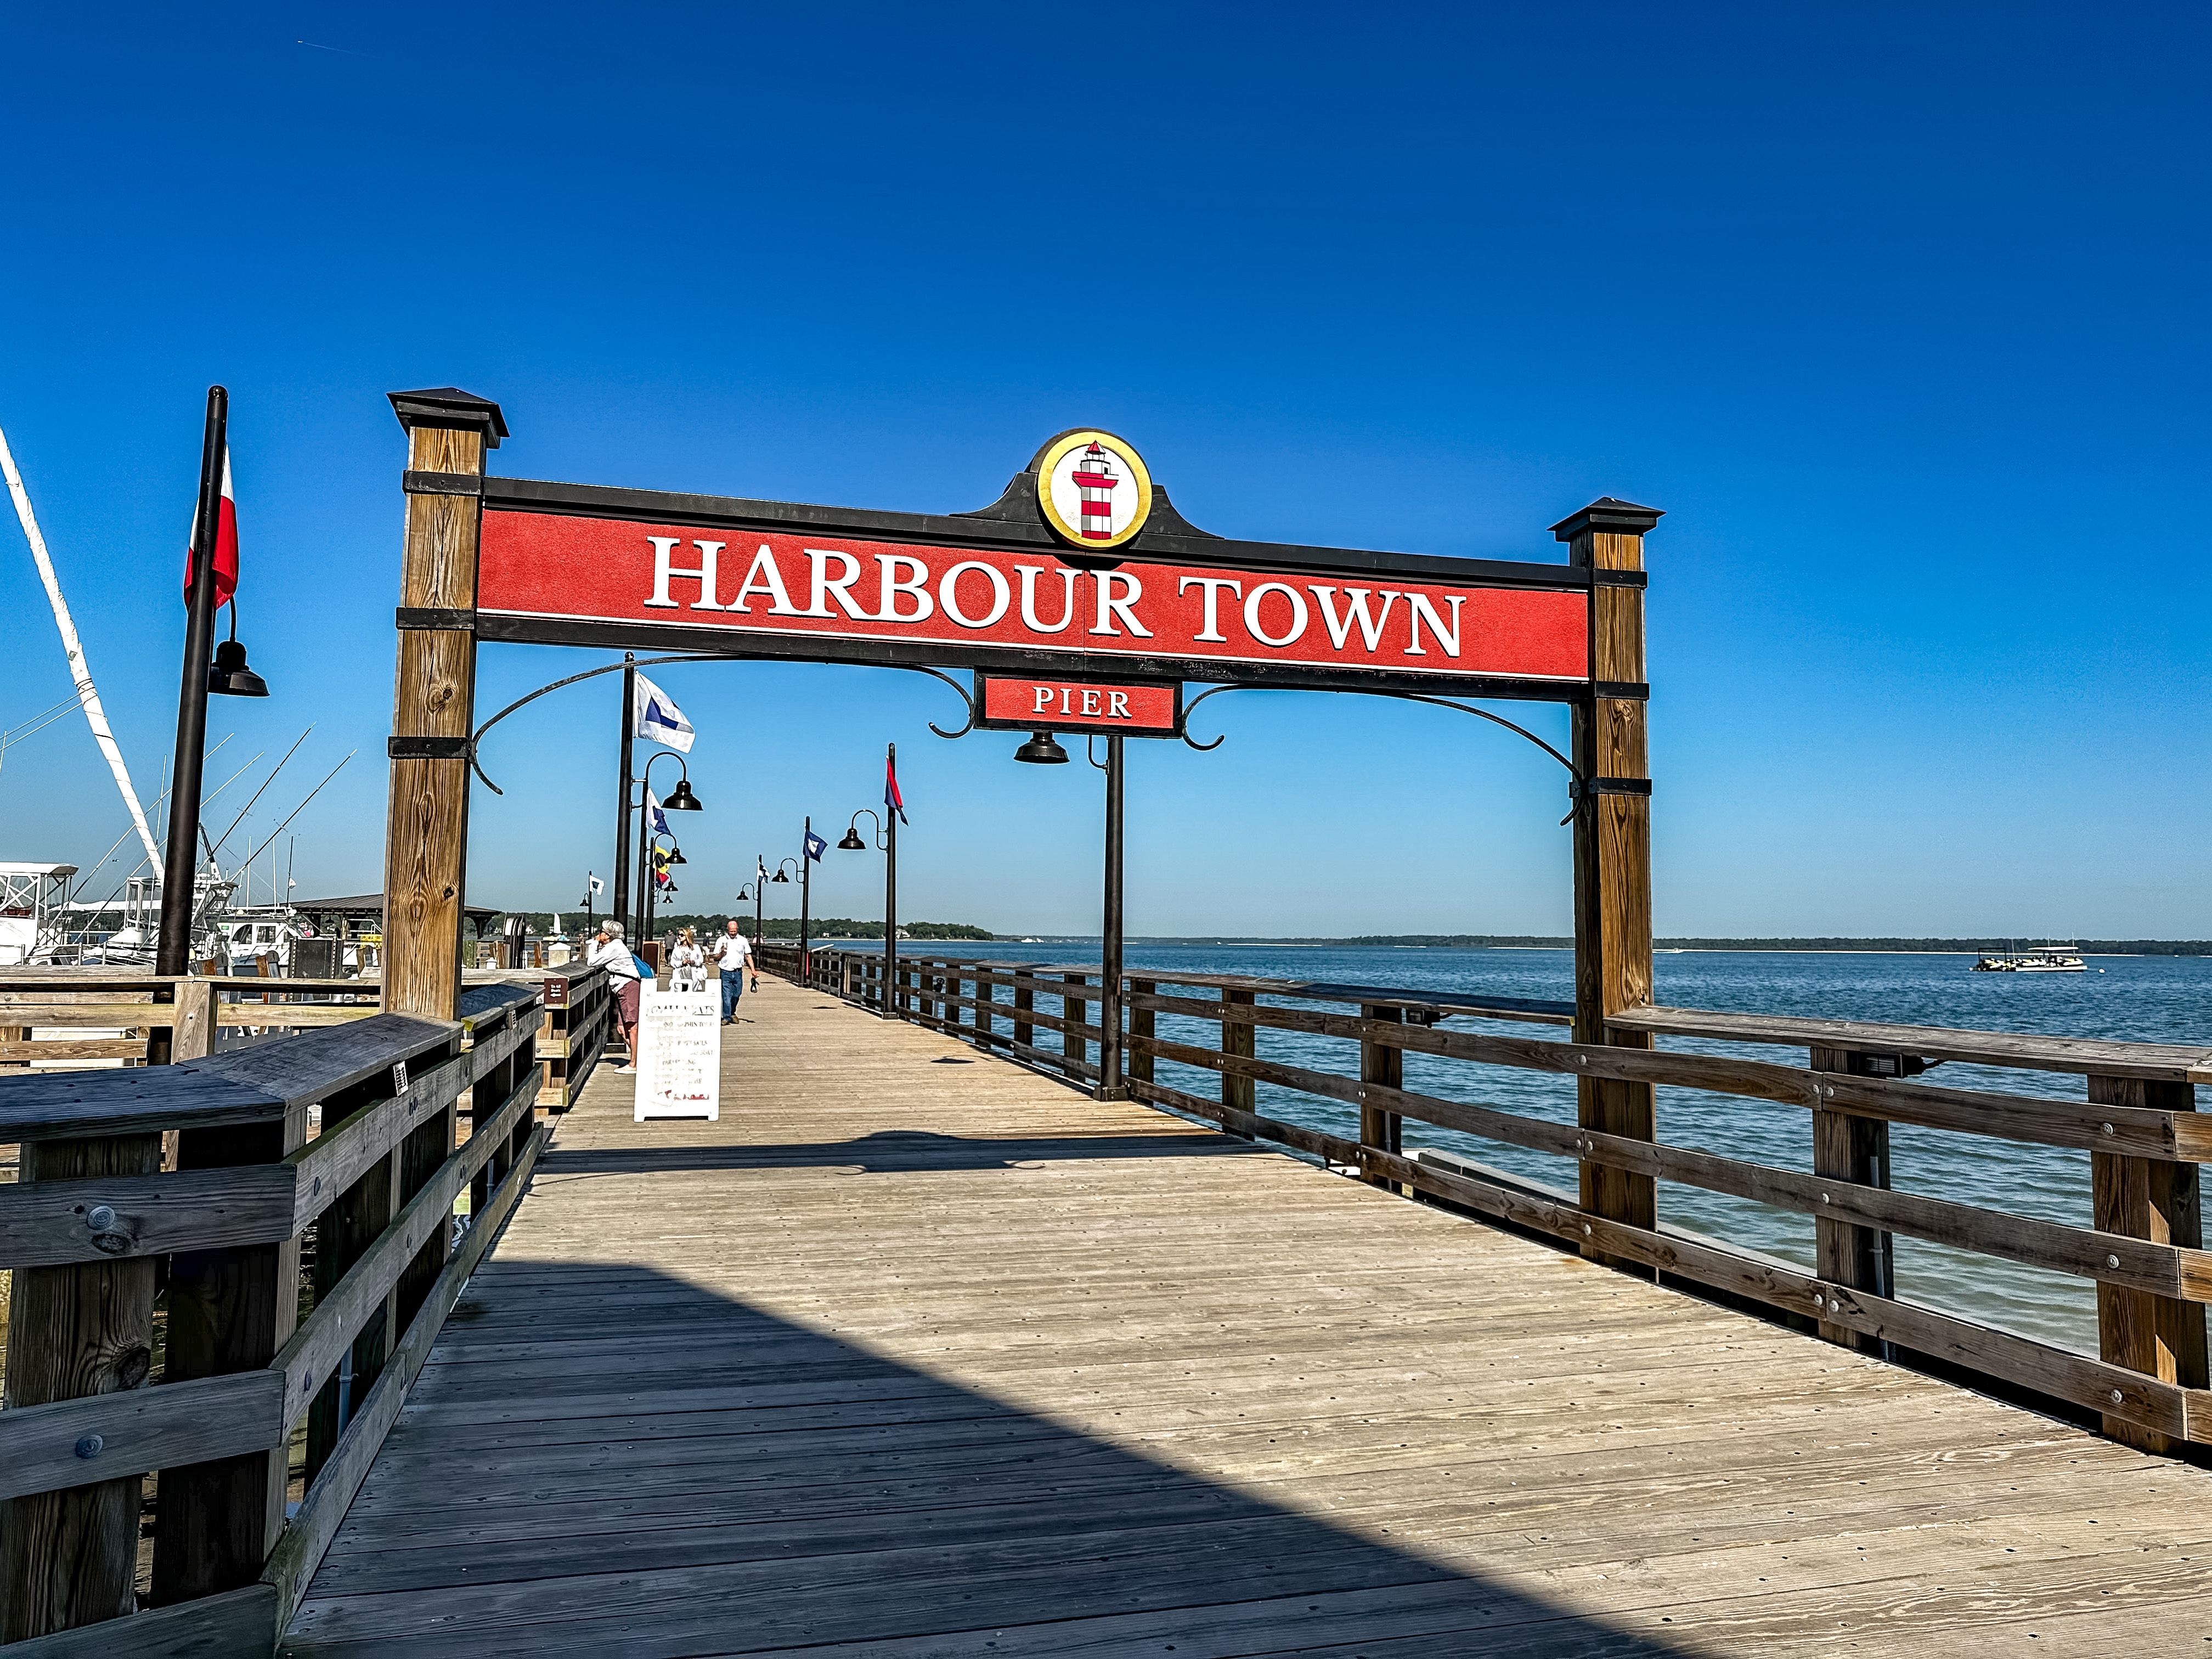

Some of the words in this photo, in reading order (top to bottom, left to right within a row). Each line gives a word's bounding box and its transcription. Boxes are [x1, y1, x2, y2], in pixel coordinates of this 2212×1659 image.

[644, 535, 1154, 637] HARBOUR
[1179, 576, 1468, 657] TOWN
[1032, 686, 1133, 719] PIER
